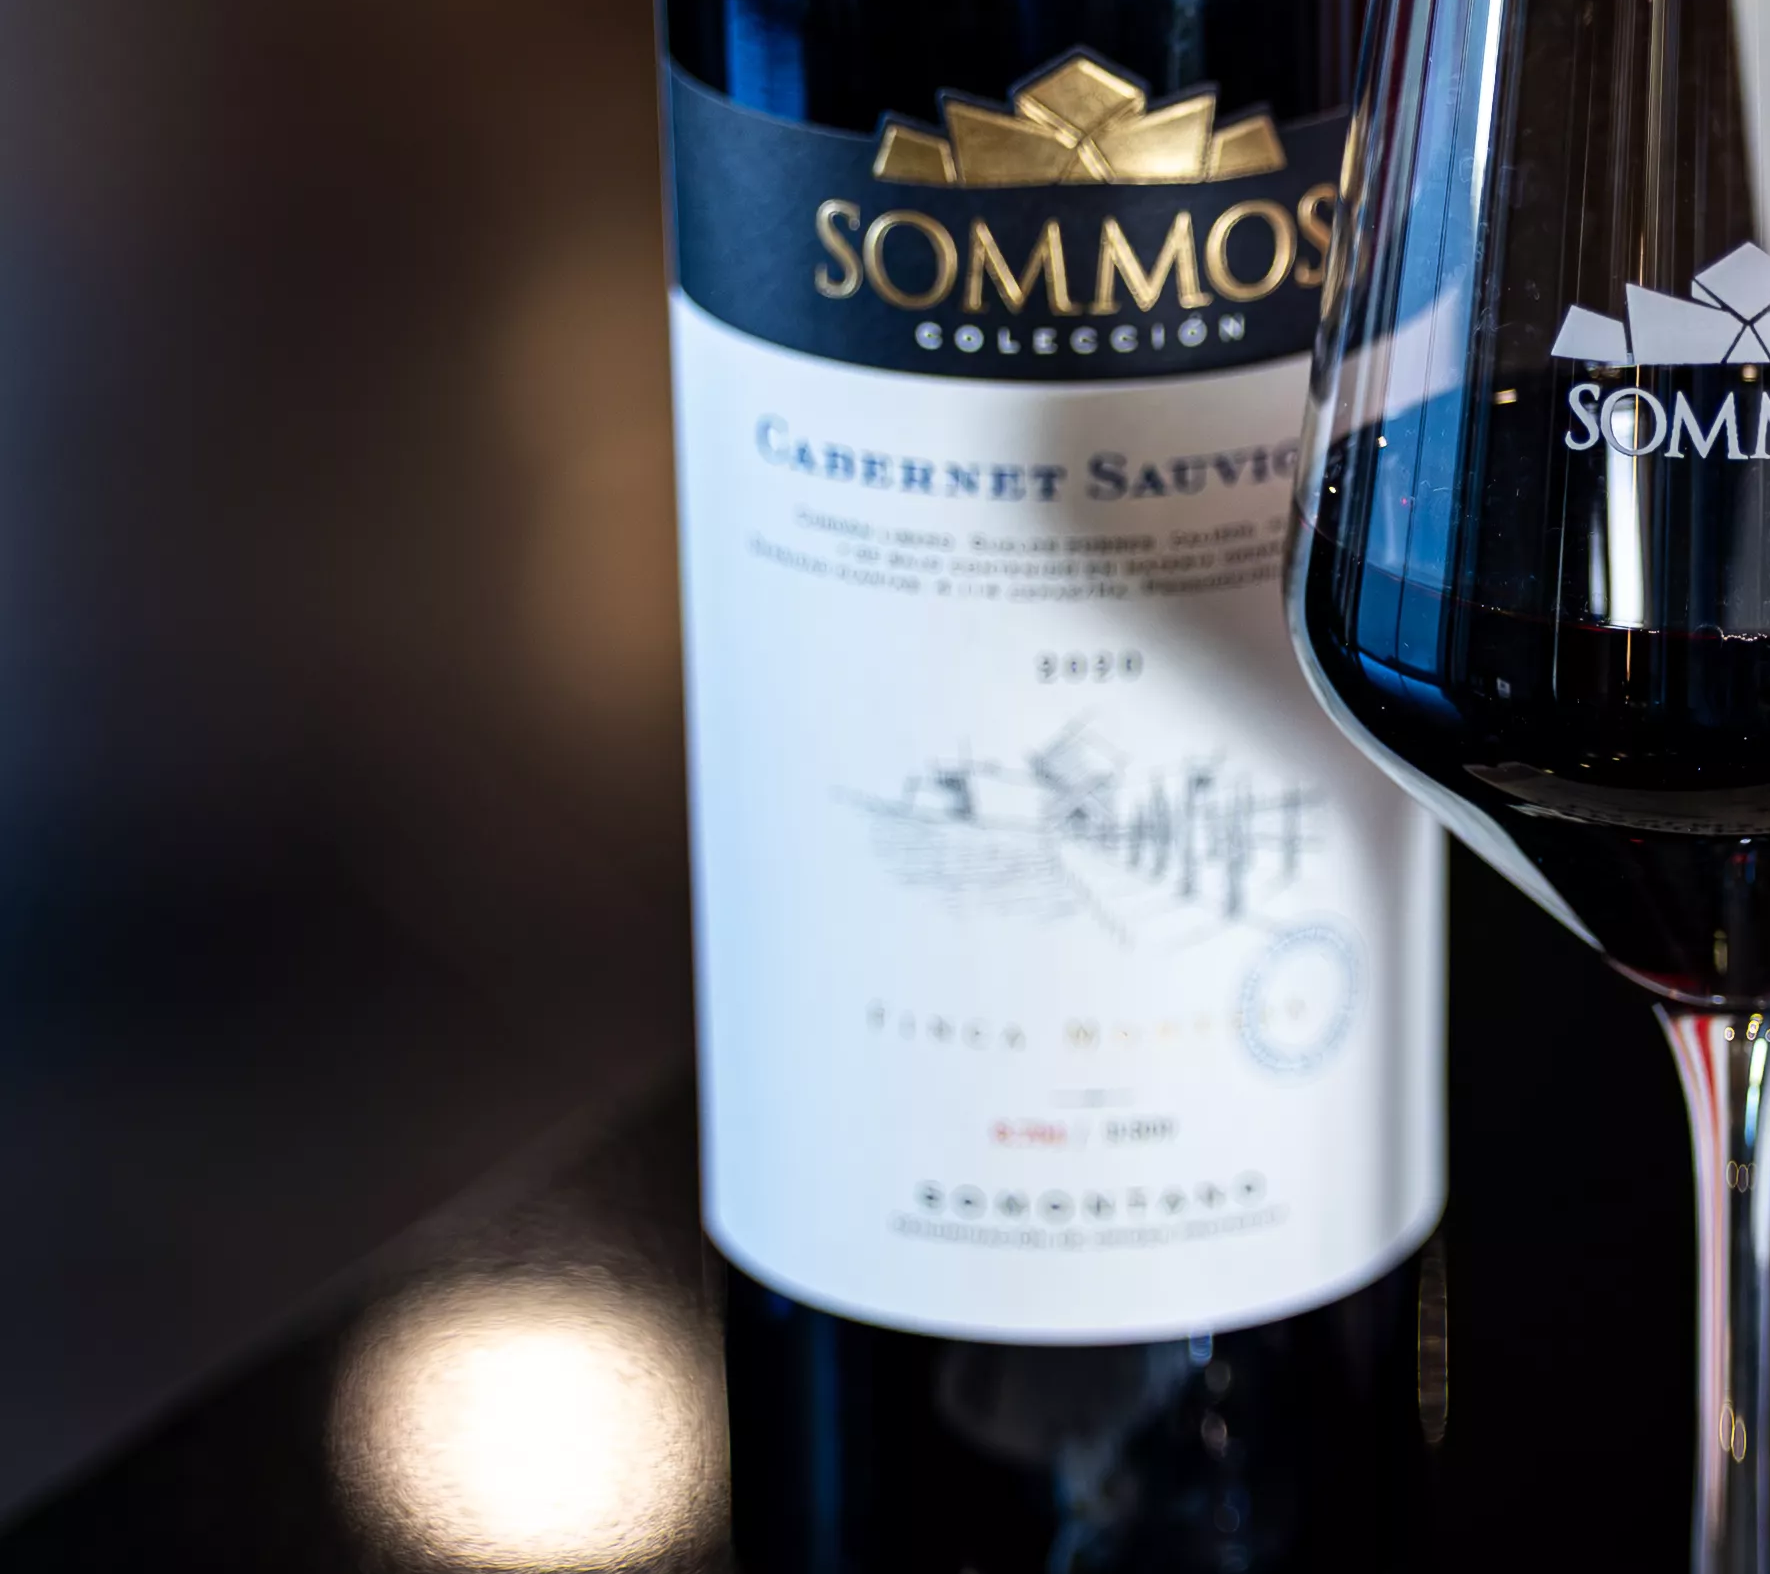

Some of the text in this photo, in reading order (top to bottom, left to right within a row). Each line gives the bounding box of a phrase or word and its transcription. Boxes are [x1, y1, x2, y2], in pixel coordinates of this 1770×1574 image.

[814, 184, 1338, 315] SOMMOS
[914, 311, 1246, 355] COLECCIÓN
[754, 413, 1068, 503] CABERNET
